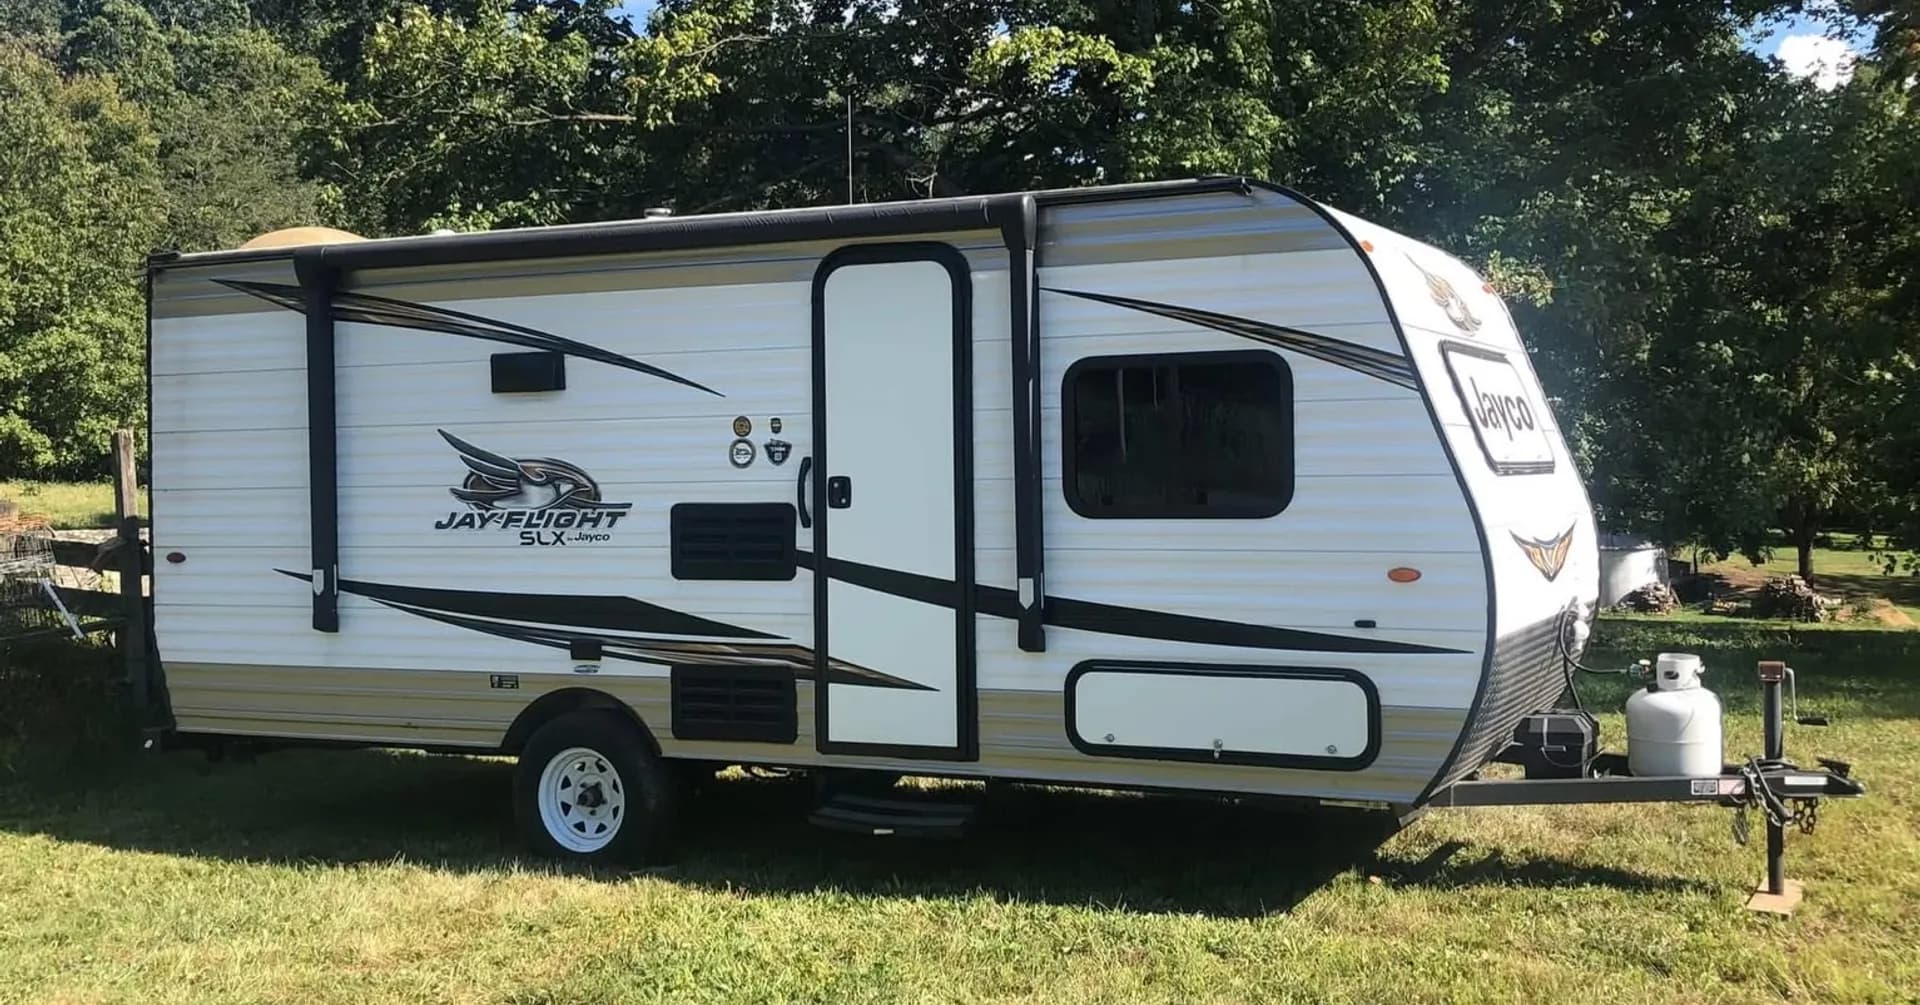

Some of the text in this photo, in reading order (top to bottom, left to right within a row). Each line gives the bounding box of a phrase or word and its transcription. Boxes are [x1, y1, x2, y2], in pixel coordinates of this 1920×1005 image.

[1469, 376, 1534, 442] Jayco
[519, 531, 610, 546] SLX Jayco
